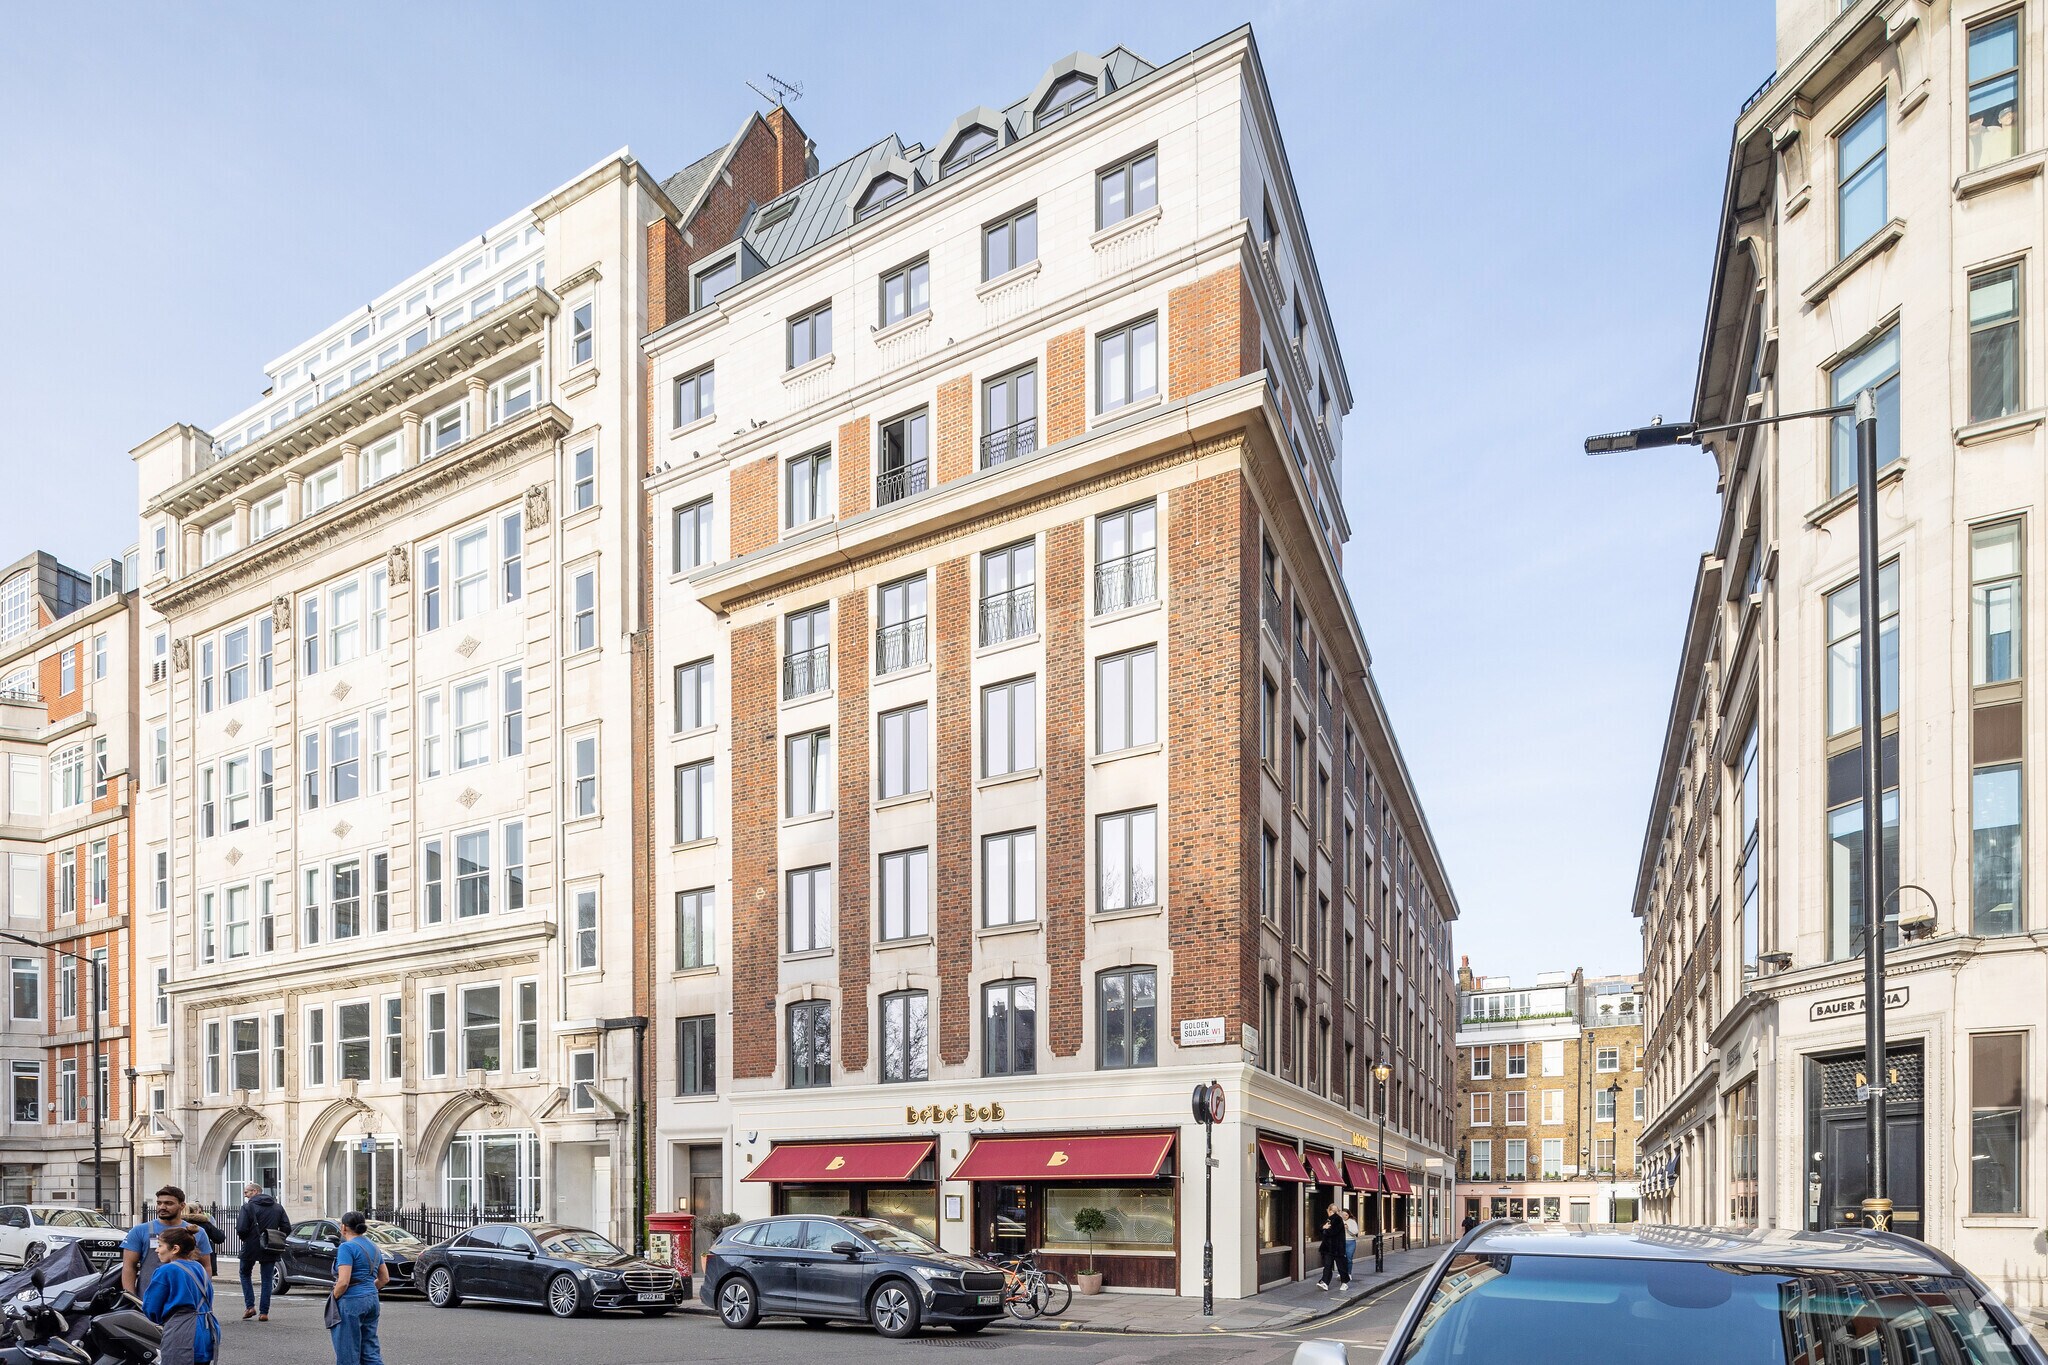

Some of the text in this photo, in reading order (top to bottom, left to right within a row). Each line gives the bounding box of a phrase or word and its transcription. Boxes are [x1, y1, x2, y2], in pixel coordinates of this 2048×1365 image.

[1816, 1001, 1855, 1016] BAUER
[1184, 1021, 1209, 1030] GOLDEN
[1184, 1028, 1209, 1037] SQUARE
[963, 1101, 1005, 1123] bob
